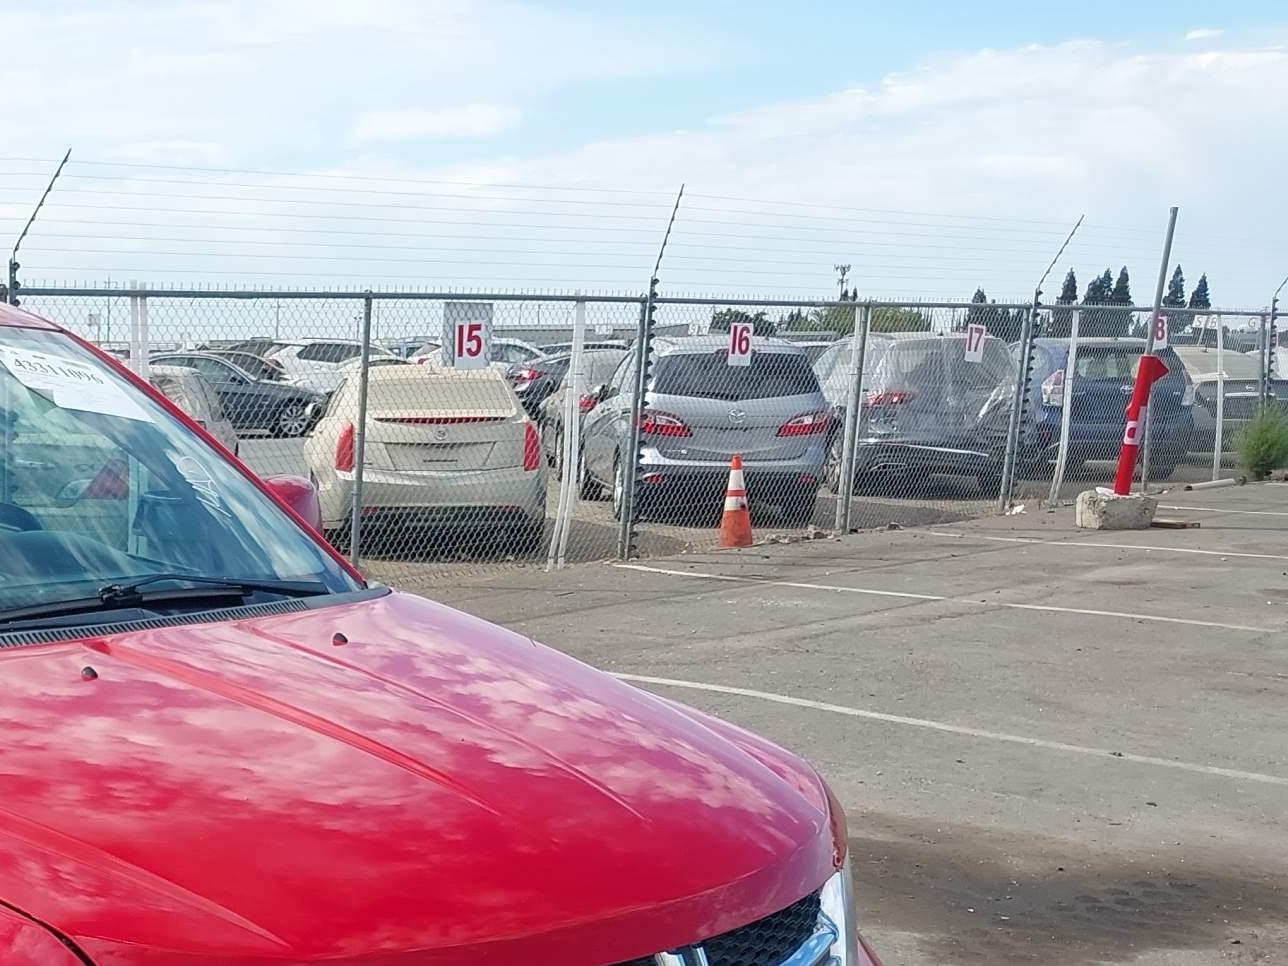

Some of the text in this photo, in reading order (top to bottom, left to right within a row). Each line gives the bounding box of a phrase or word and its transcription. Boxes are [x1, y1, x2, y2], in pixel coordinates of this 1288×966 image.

[457, 324, 482, 357] 15
[731, 325, 750, 355] 16
[968, 326, 984, 352] 17
